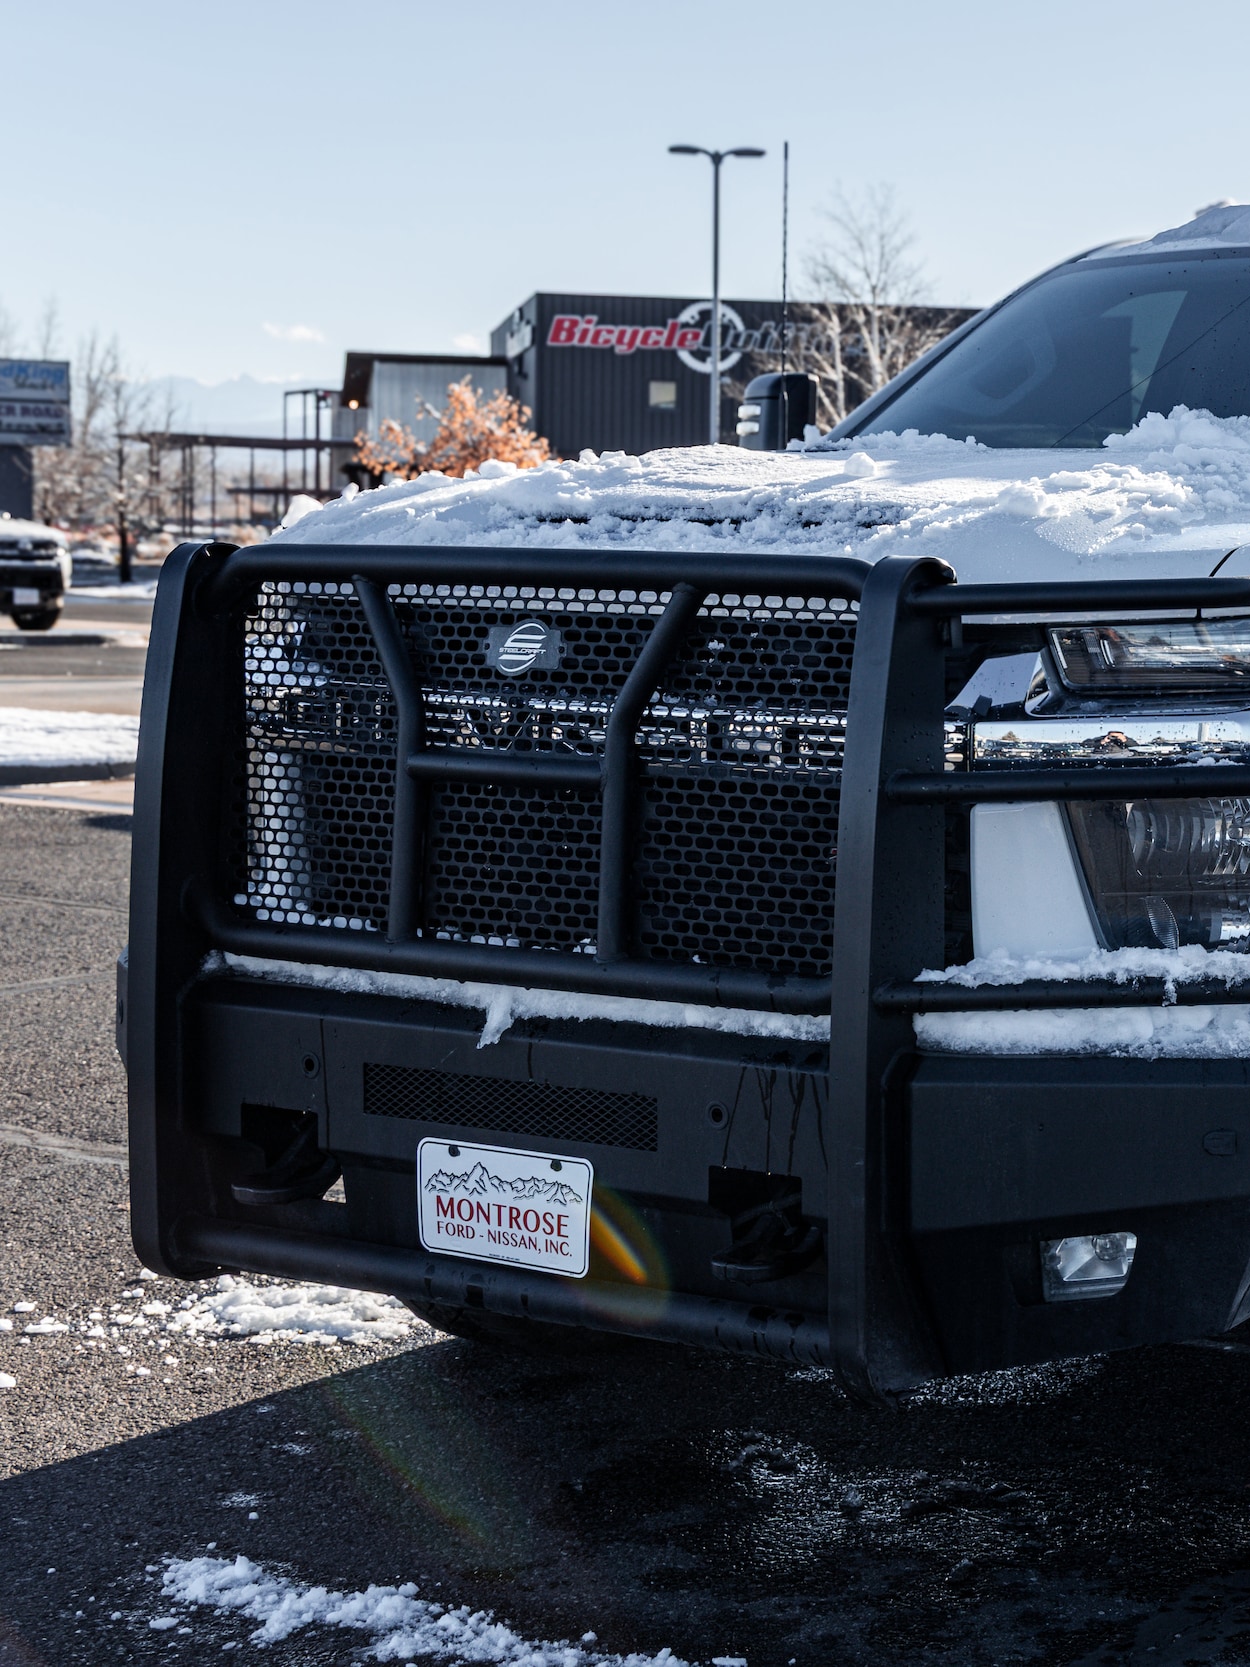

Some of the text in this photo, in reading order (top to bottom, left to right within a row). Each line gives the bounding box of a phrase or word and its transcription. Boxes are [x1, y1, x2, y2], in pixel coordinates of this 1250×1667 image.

[547, 315, 702, 354] Bicycle
[436, 1195, 570, 1239] MONTROSE
[437, 1221, 476, 1240] FORD
[487, 1229, 542, 1255] NISSAN,
[545, 1239, 573, 1258] INC.
